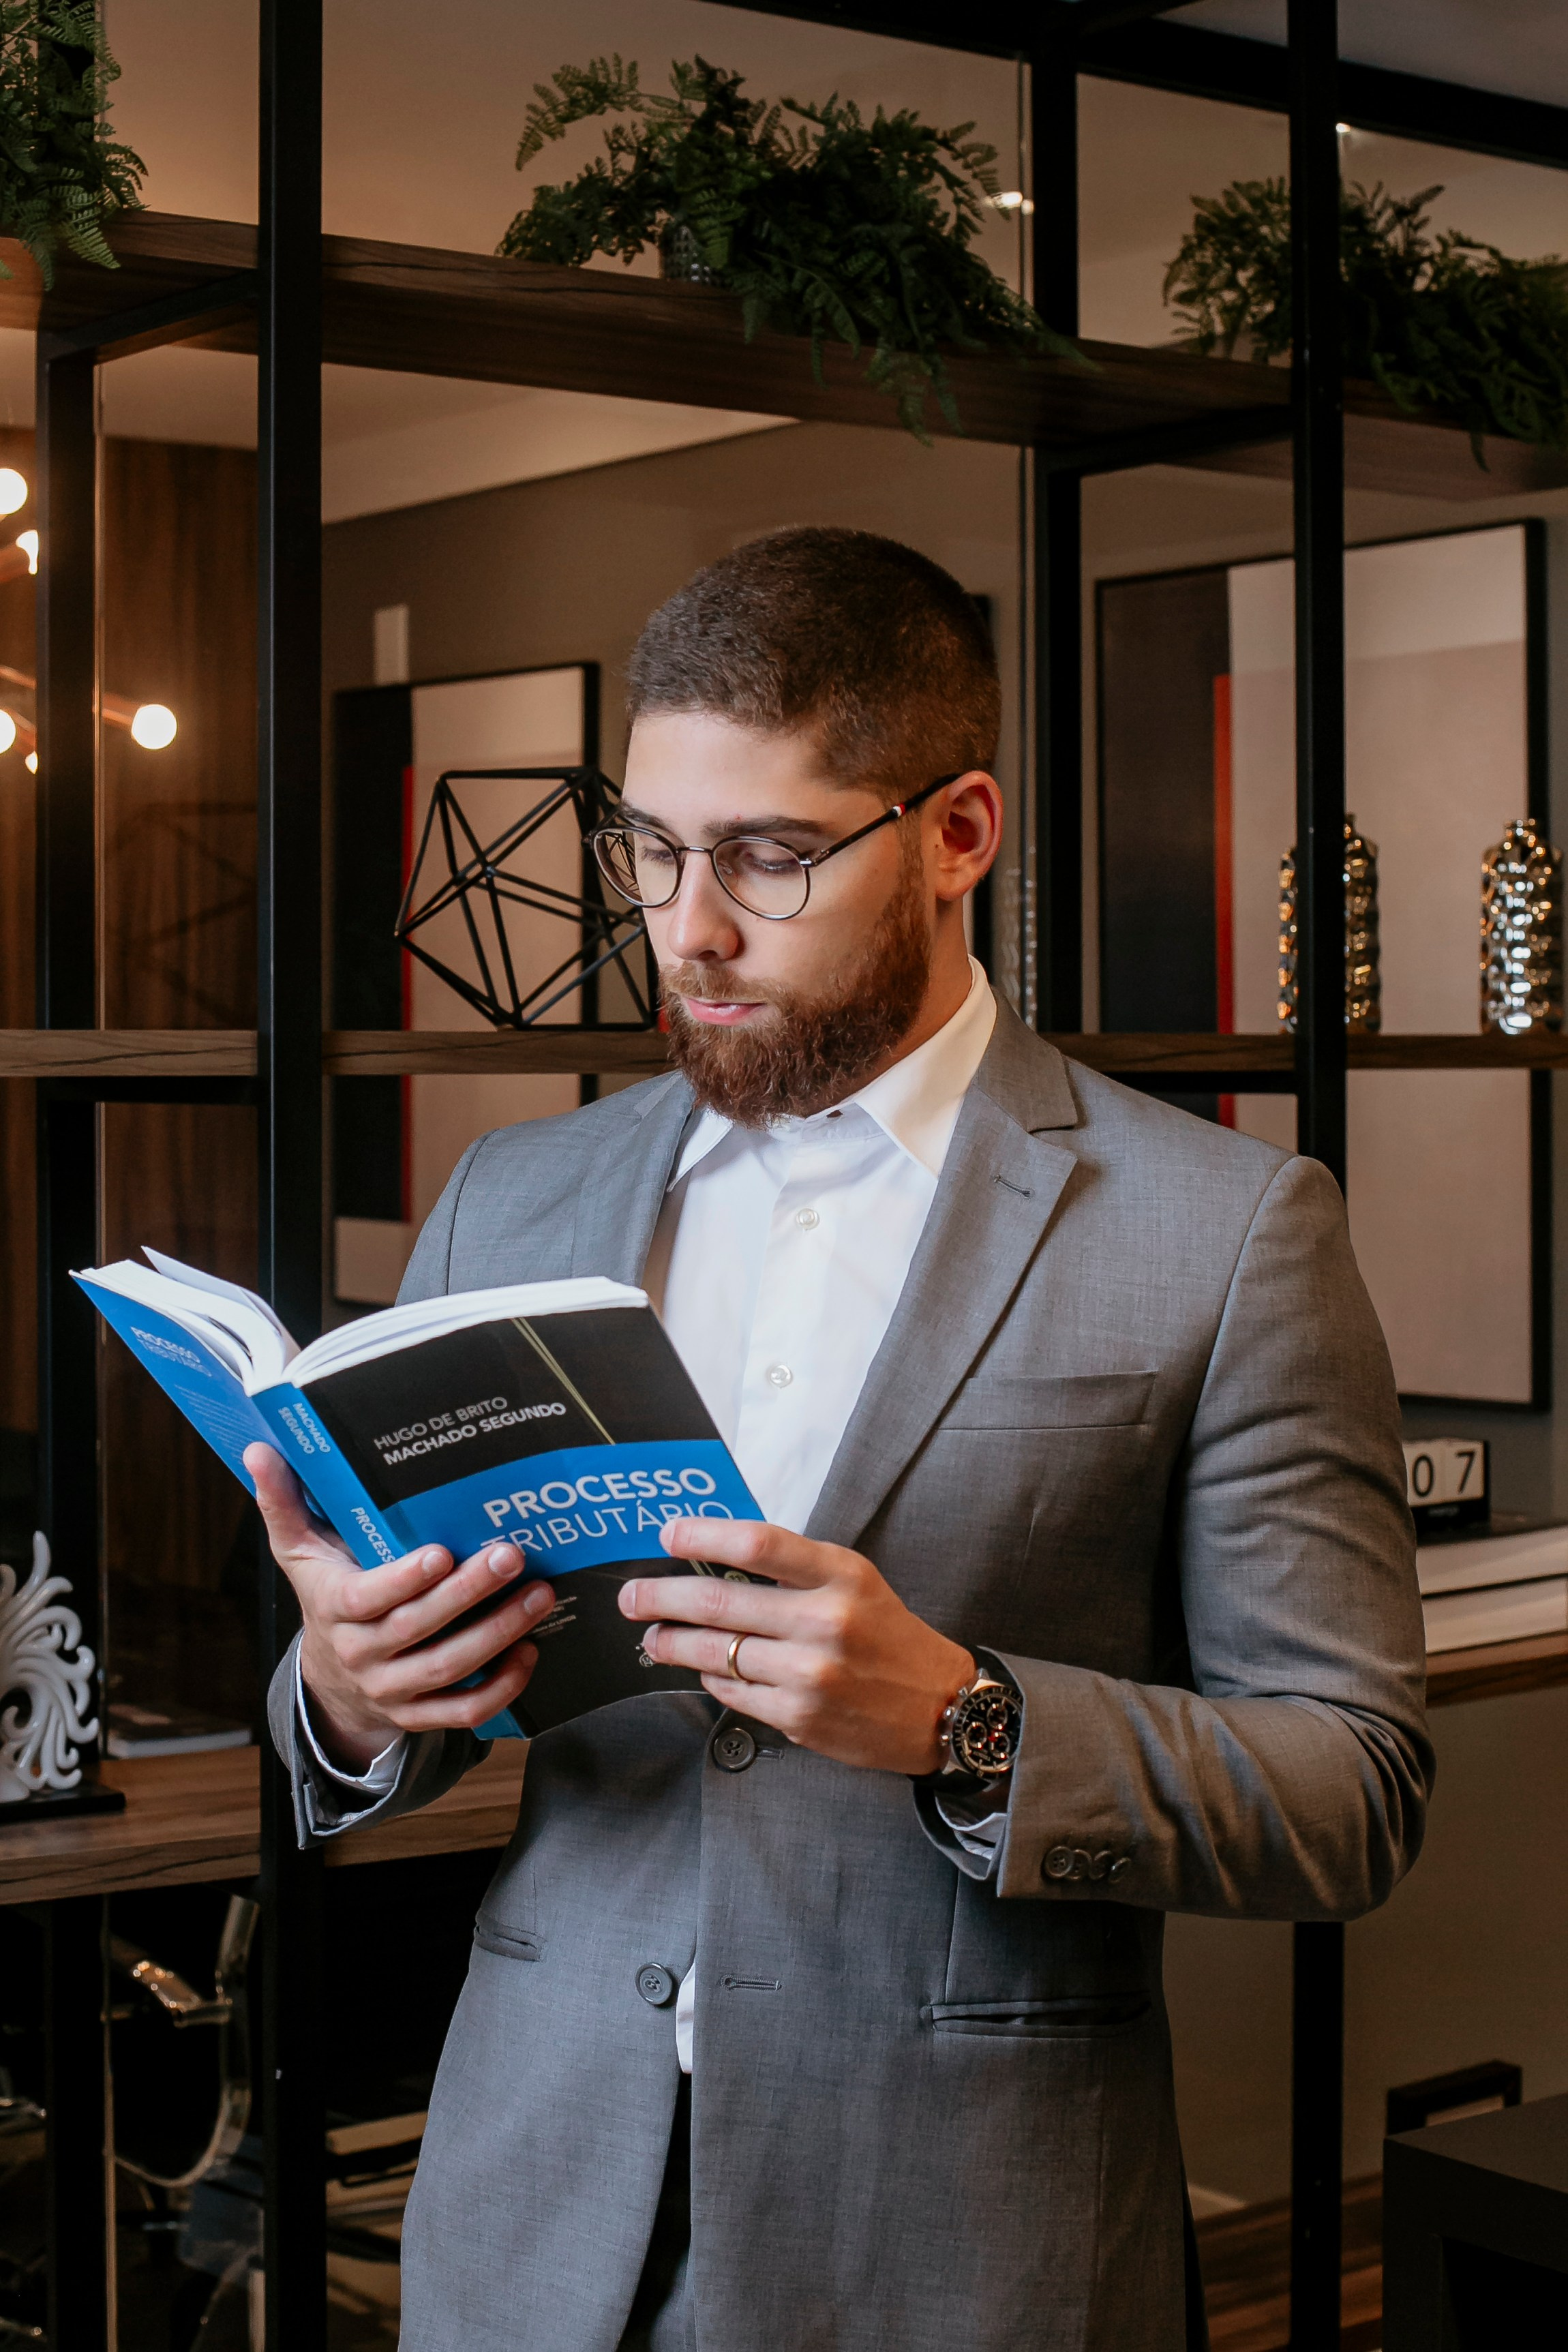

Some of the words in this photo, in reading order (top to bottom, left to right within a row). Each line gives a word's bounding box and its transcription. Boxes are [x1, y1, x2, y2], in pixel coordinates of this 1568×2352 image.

[278, 1406, 315, 1454] SEGUNDO
[293, 1403, 331, 1453] MACHADO
[374, 1423, 427, 1450] HUGO
[428, 1412, 455, 1430] DE
[455, 1396, 508, 1421] BRITO
[383, 1424, 477, 1465] MACHADO
[479, 1402, 567, 1432] SEGUNDO
[483, 1467, 717, 1528] PROCESSO
[350, 1507, 396, 1563] PROCESS
